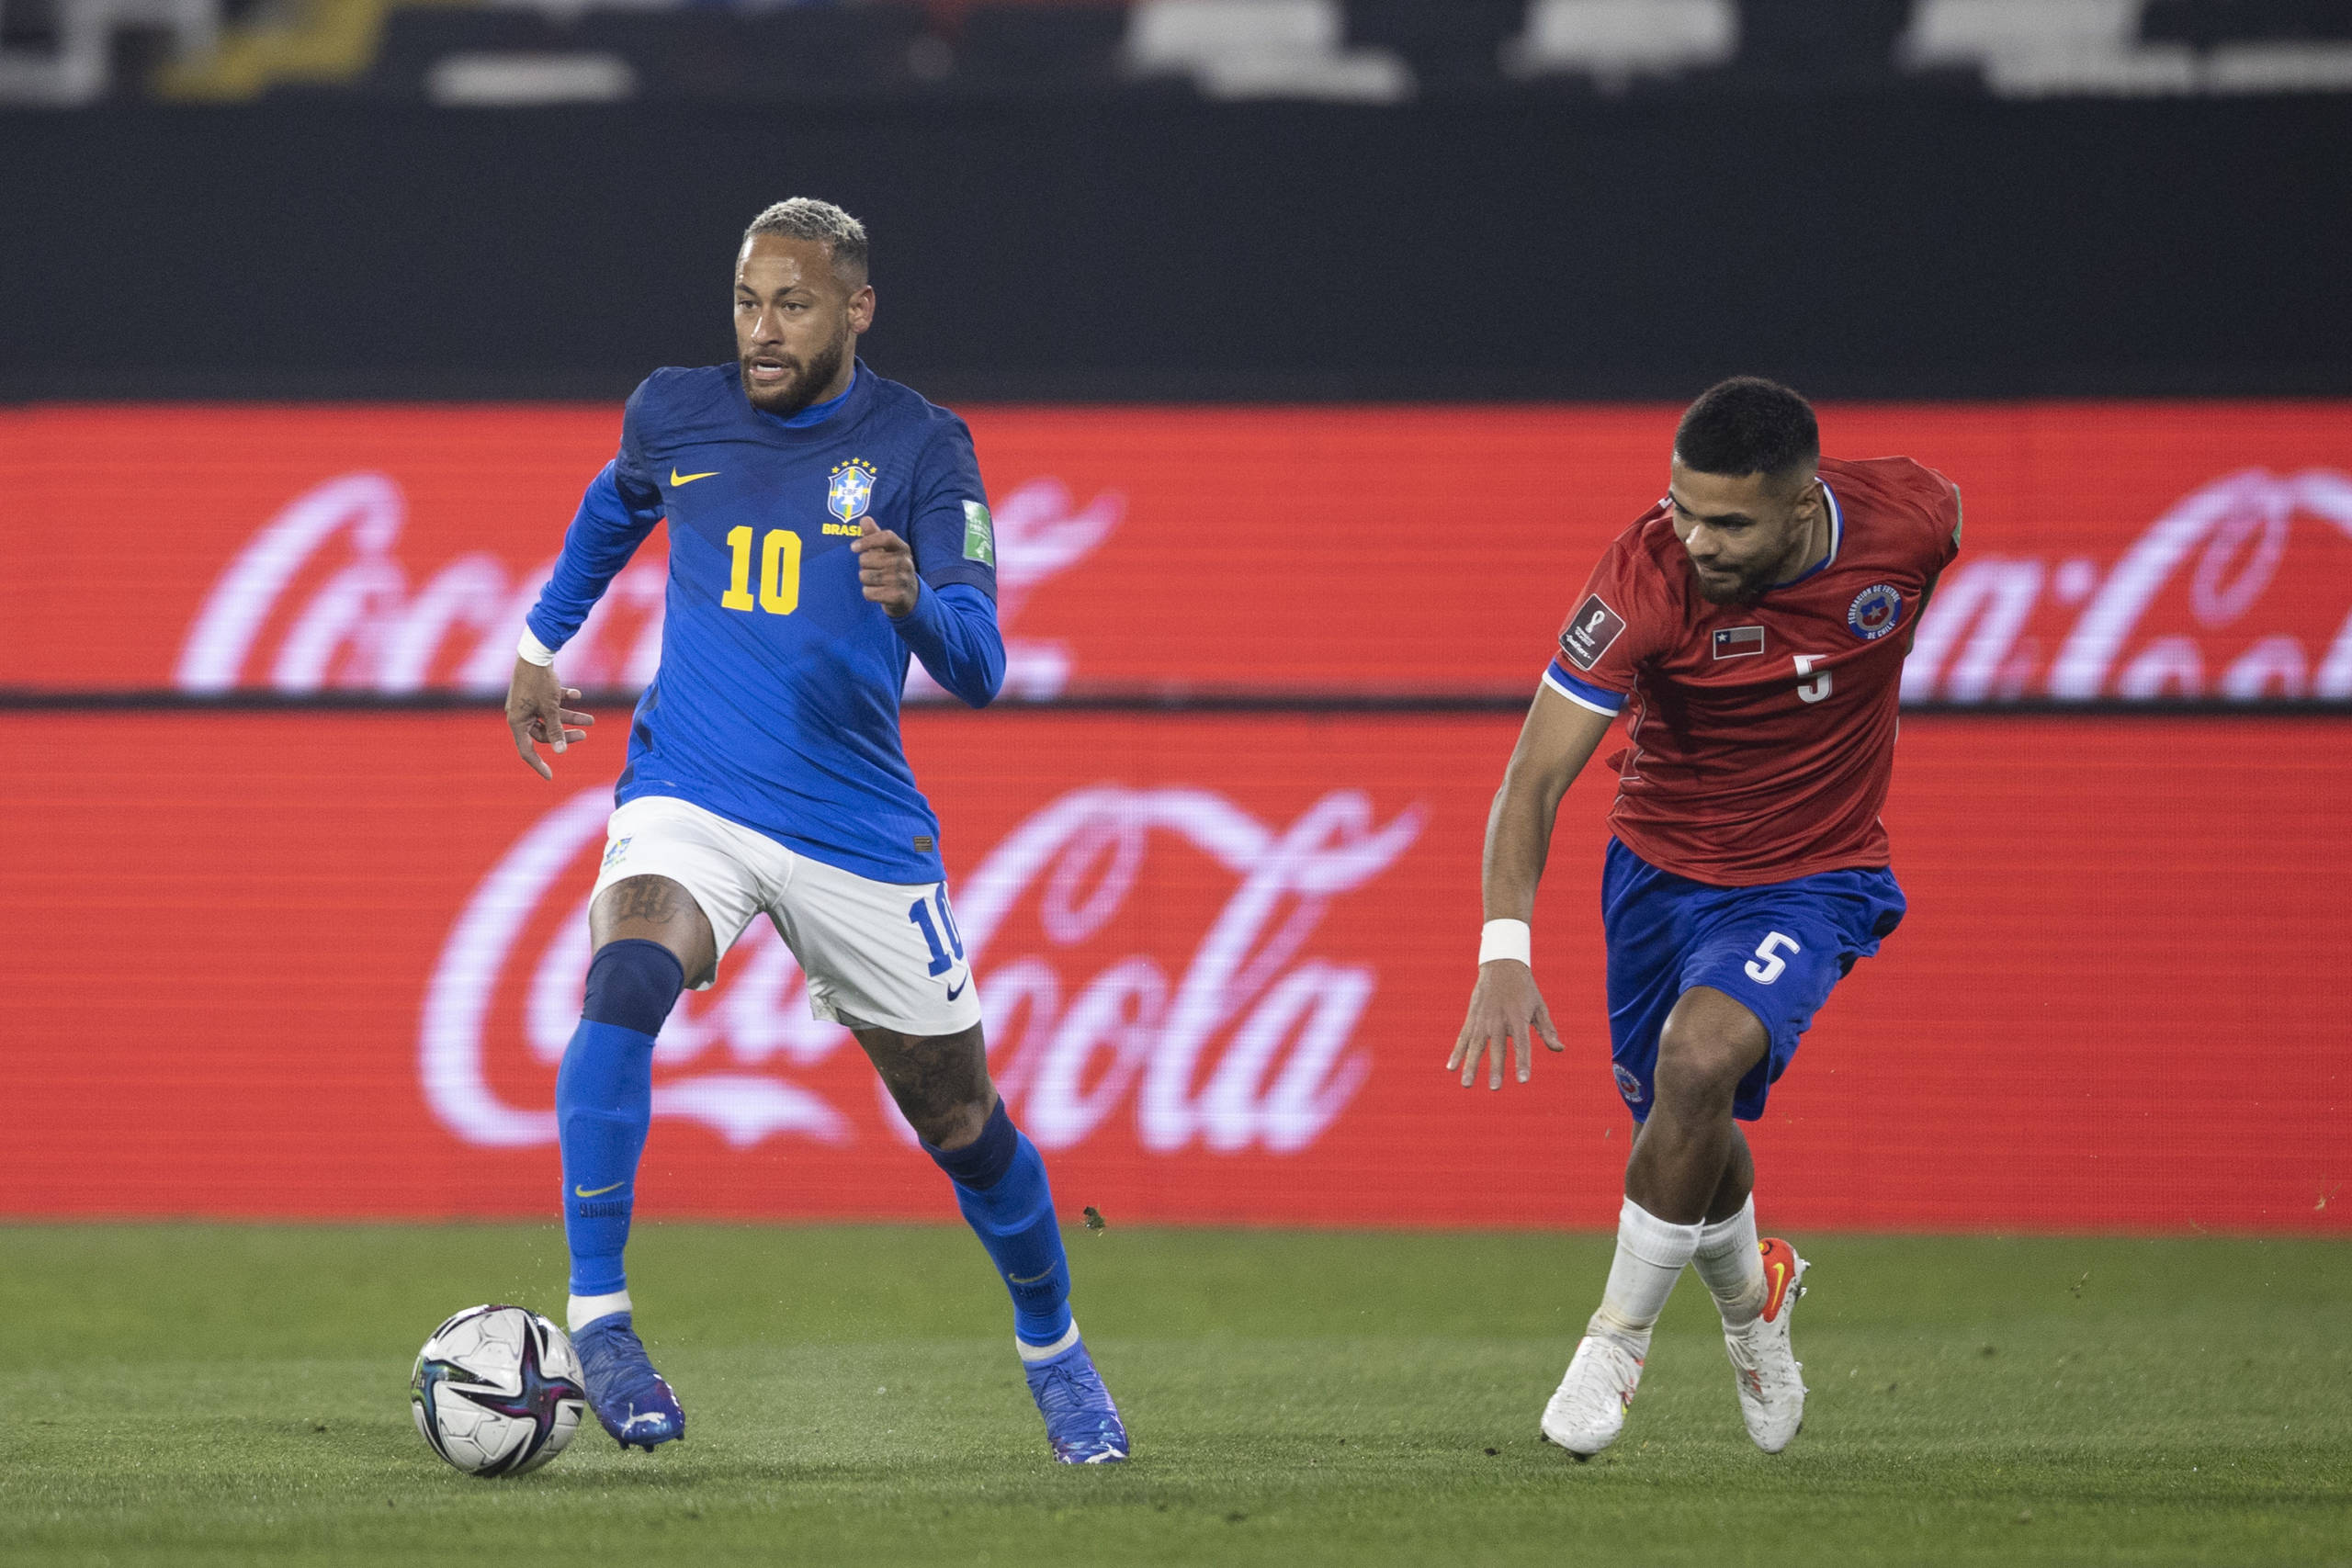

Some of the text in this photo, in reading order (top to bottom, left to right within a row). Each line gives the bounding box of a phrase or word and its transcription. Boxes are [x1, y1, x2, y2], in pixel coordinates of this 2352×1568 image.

[822, 523, 862, 536] BRASI
[721, 525, 802, 615] 10
[1873, 584, 1883, 592] DE
[1793, 654, 1832, 704] 5
[909, 881, 964, 977] 10
[1745, 931, 1801, 985] 5
